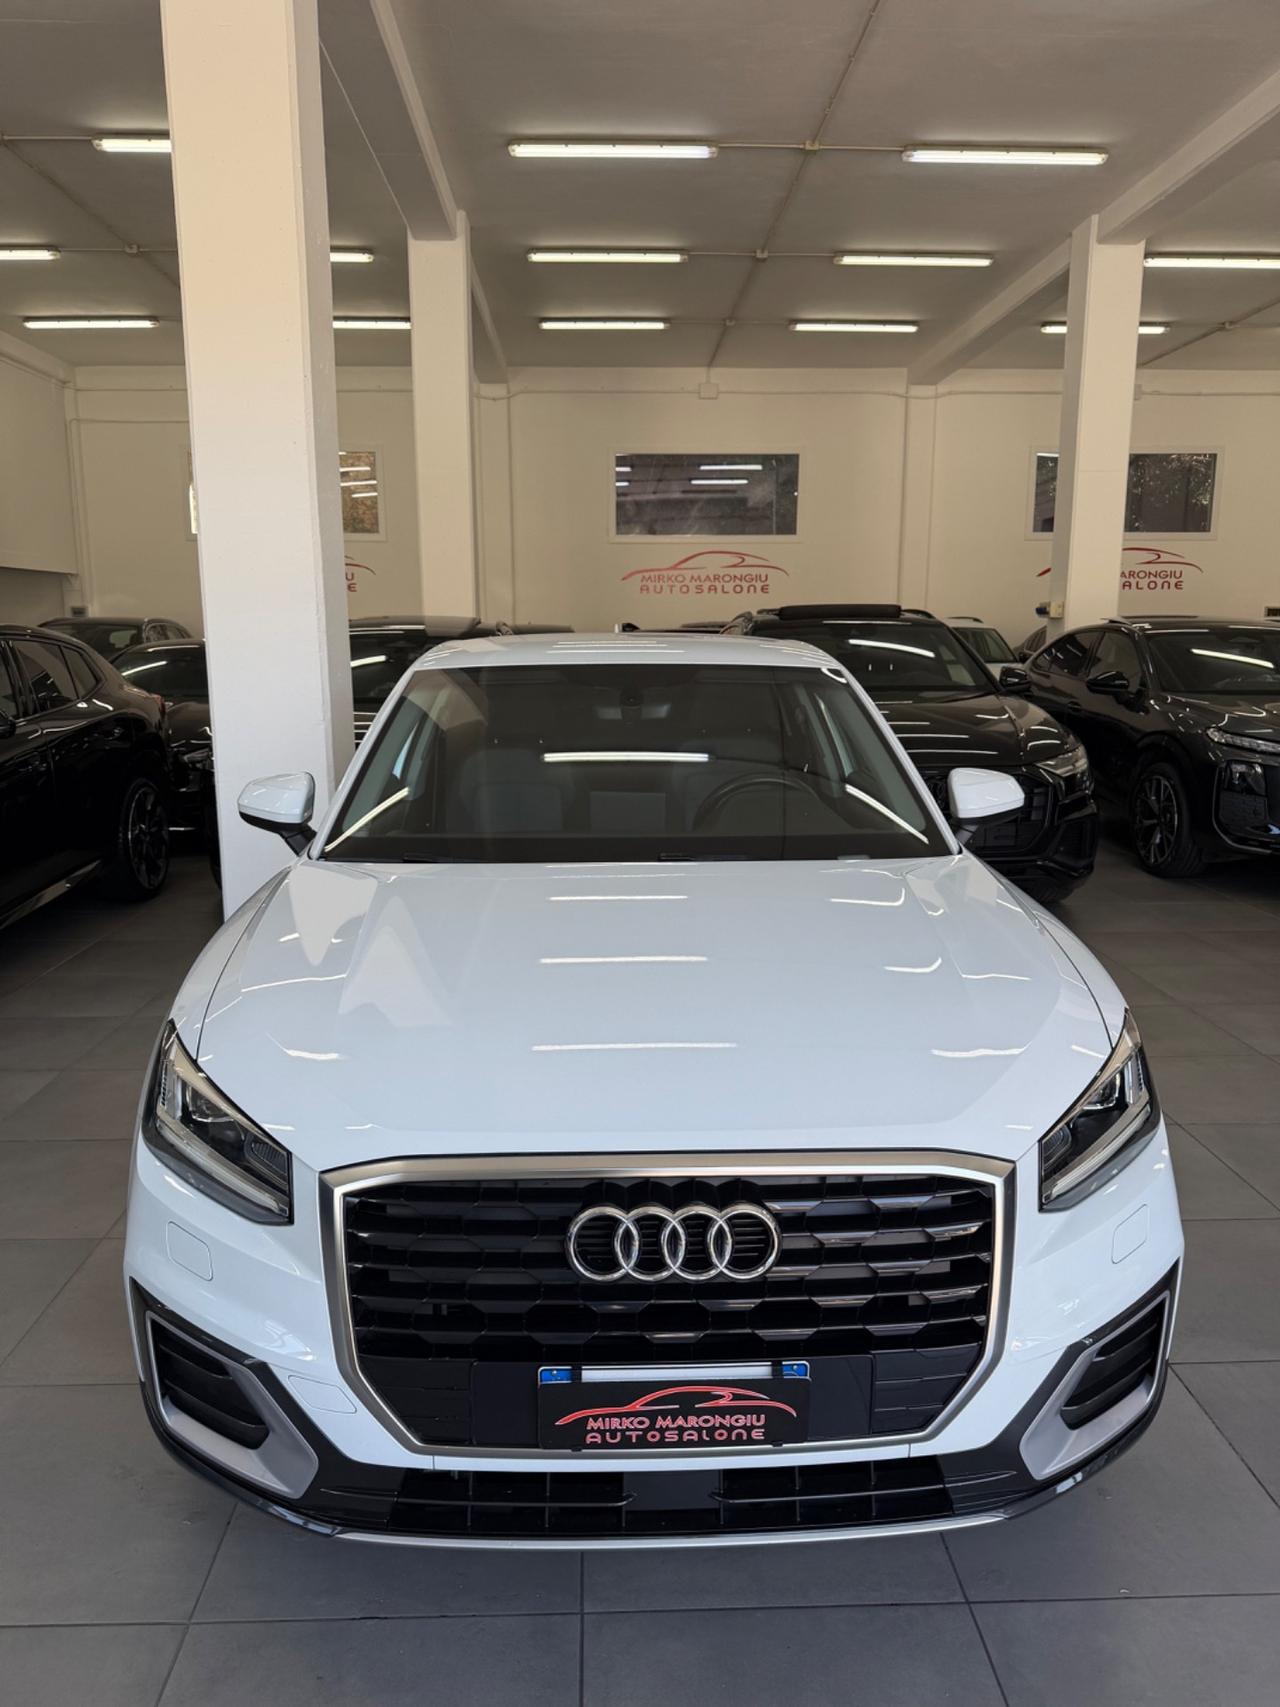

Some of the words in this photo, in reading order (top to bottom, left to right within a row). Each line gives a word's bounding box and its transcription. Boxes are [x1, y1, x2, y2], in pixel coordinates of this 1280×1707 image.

[640, 573, 687, 583] MIRKO
[689, 573, 769, 583] MARONGIU
[1120, 570, 1183, 580] ARONGIU
[640, 584, 770, 594] AUTOSALONE
[586, 1416, 649, 1430] MIRKO
[655, 1414, 766, 1429] MARONGIU
[586, 1429, 766, 1444] AUTOSALONE
